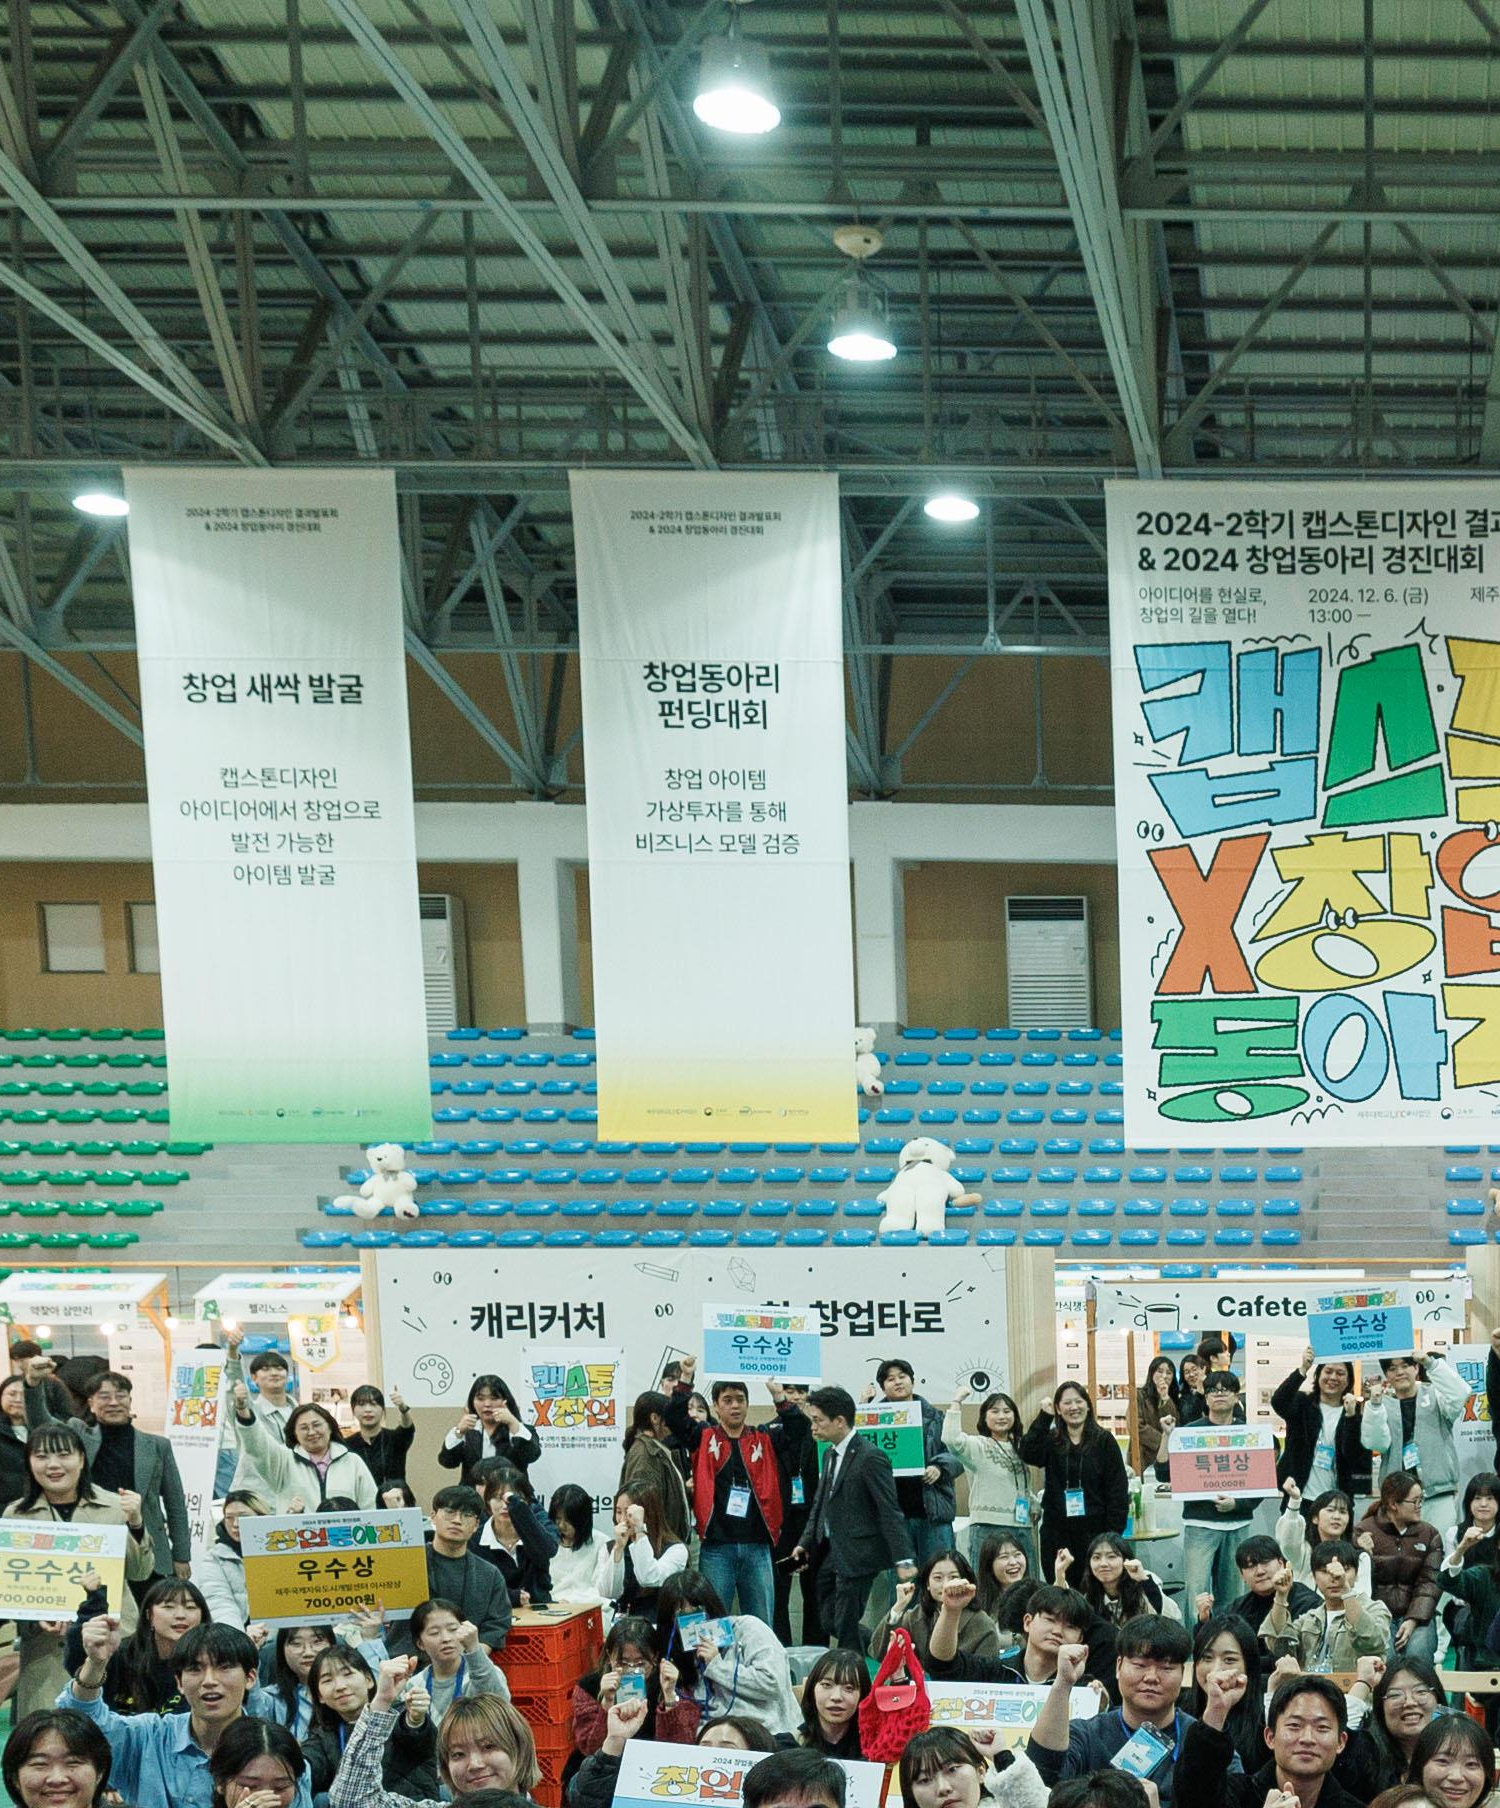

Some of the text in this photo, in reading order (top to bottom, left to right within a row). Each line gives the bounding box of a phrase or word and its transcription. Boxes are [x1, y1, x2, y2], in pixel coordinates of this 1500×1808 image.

[1137, 511, 1295, 540] 2024-2학기
[1301, 509, 1457, 539] 캡스톤디자인
[1138, 544, 1485, 575] & 2024 창업동아리 경진대회
[1138, 586, 1268, 606] 아이디어를 현실로,
[1308, 585, 1430, 607] 2024. 12. 6. (금)
[1139, 606, 1257, 625] 창업의 길을 열다!
[1308, 609, 1355, 624] 13:00
[182, 673, 364, 704] 창업 새싹 발굴
[642, 662, 780, 694] 창업동아리
[657, 699, 769, 730] 펀딩대회
[219, 767, 338, 790] 캡스톤디자인
[664, 768, 767, 791] 창업 아이템
[179, 799, 382, 821] 아이디어에서 창업으로
[646, 801, 787, 823] 가상투자를 통해
[231, 831, 335, 854] 발전 가능한
[635, 832, 801, 855] 비즈니스 모델 검증
[233, 864, 337, 886] 아이템 발굴
[1217, 1295, 1308, 1319] Cafete
[469, 1301, 605, 1340] 캐리커처
[1331, 1312, 1387, 1335] 우수상
[731, 1334, 794, 1357] 우수상
[1194, 1452, 1250, 1474] 특별상
[296, 1554, 375, 1580] 우수상
[303, 1593, 376, 1610] 700,000원
